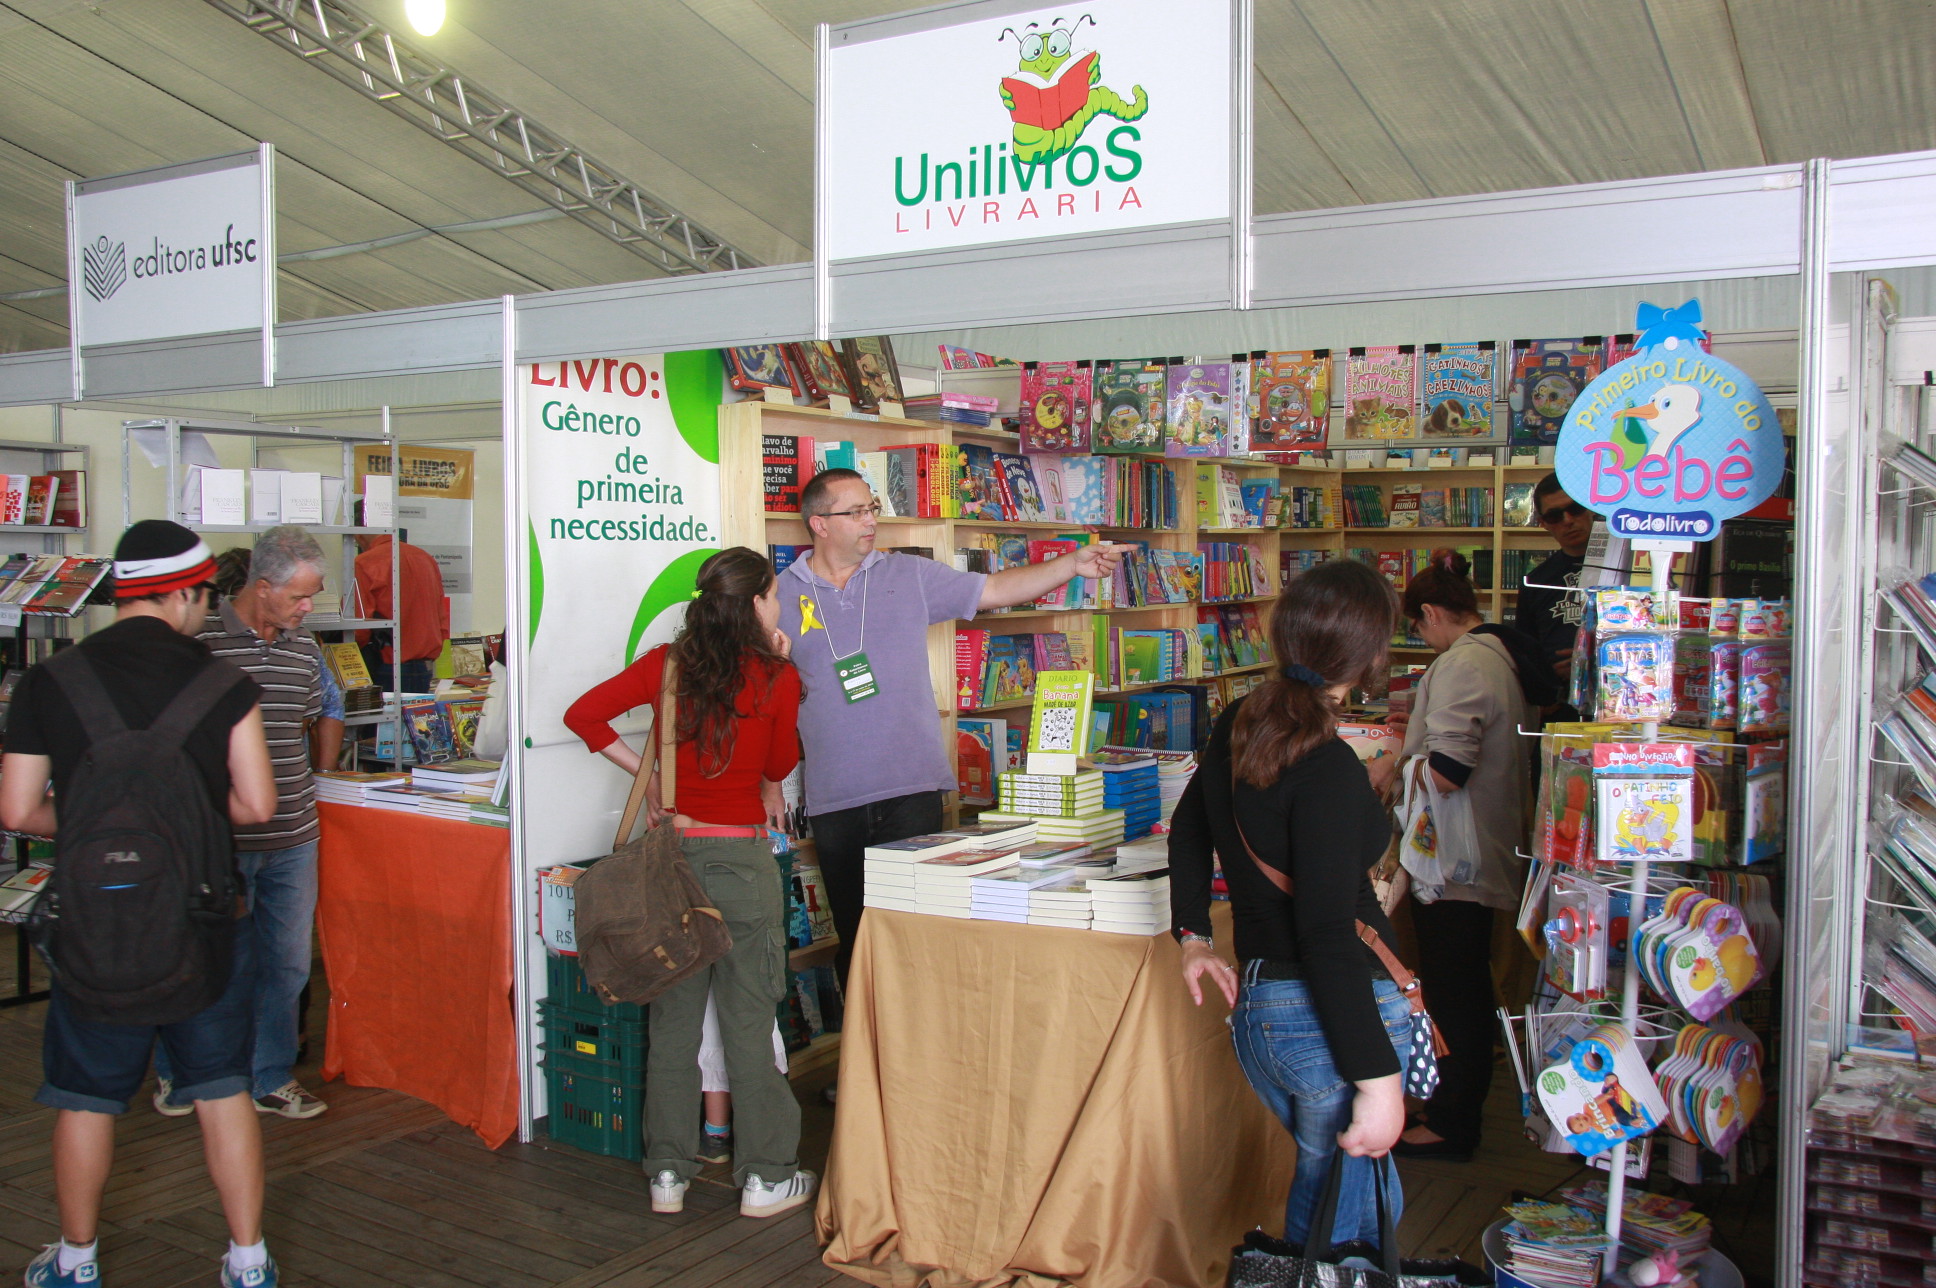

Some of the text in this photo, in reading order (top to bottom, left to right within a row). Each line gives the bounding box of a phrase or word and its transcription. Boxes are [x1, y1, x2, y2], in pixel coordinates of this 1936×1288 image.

[895, 186, 1143, 234] LIVRARIA
[133, 224, 257, 279] editora ufsc
[1350, 360, 1410, 384] FILHOTES
[1428, 356, 1484, 376] GATINHOS
[1351, 378, 1410, 398] ANIMAIS
[1426, 377, 1490, 398] CÃEZINHOS
[1576, 357, 1763, 433] Primeiro Livro do
[541, 400, 641, 437] Gênero
[762, 436, 792, 445] lavo de
[762, 446, 794, 455] arvalho
[614, 446, 649, 475] de
[774, 465, 792, 474] você
[1582, 438, 1755, 505] Bebê
[577, 474, 684, 509] primeira
[550, 514, 716, 542] necessidade.
[1617, 512, 1710, 534] Todolivro
[1043, 689, 1080, 700] Banana
[1612, 787, 1683, 805] O FEIO
[1623, 781, 1678, 793] PATINHO
[104, 851, 141, 864] FILA
[548, 884, 563, 899] 10
[1568, 1068, 1616, 1140] Brincando
